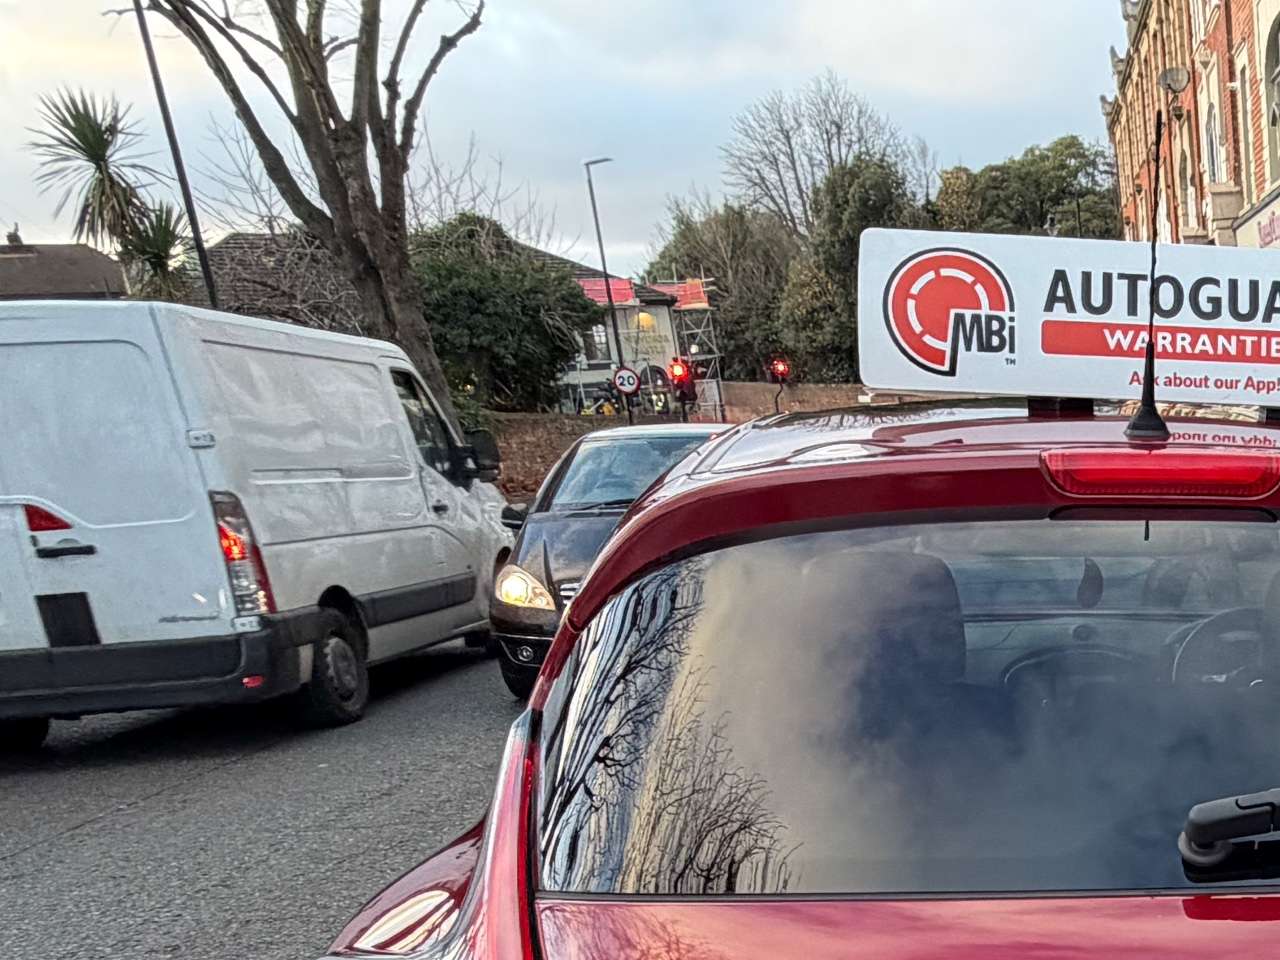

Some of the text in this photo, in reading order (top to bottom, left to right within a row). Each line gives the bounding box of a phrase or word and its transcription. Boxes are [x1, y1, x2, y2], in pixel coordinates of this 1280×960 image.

[617, 375, 636, 387] 20
[1163, 372, 1210, 389] about
[1214, 378, 1242, 390] our
[1244, 375, 1280, 395] App!
